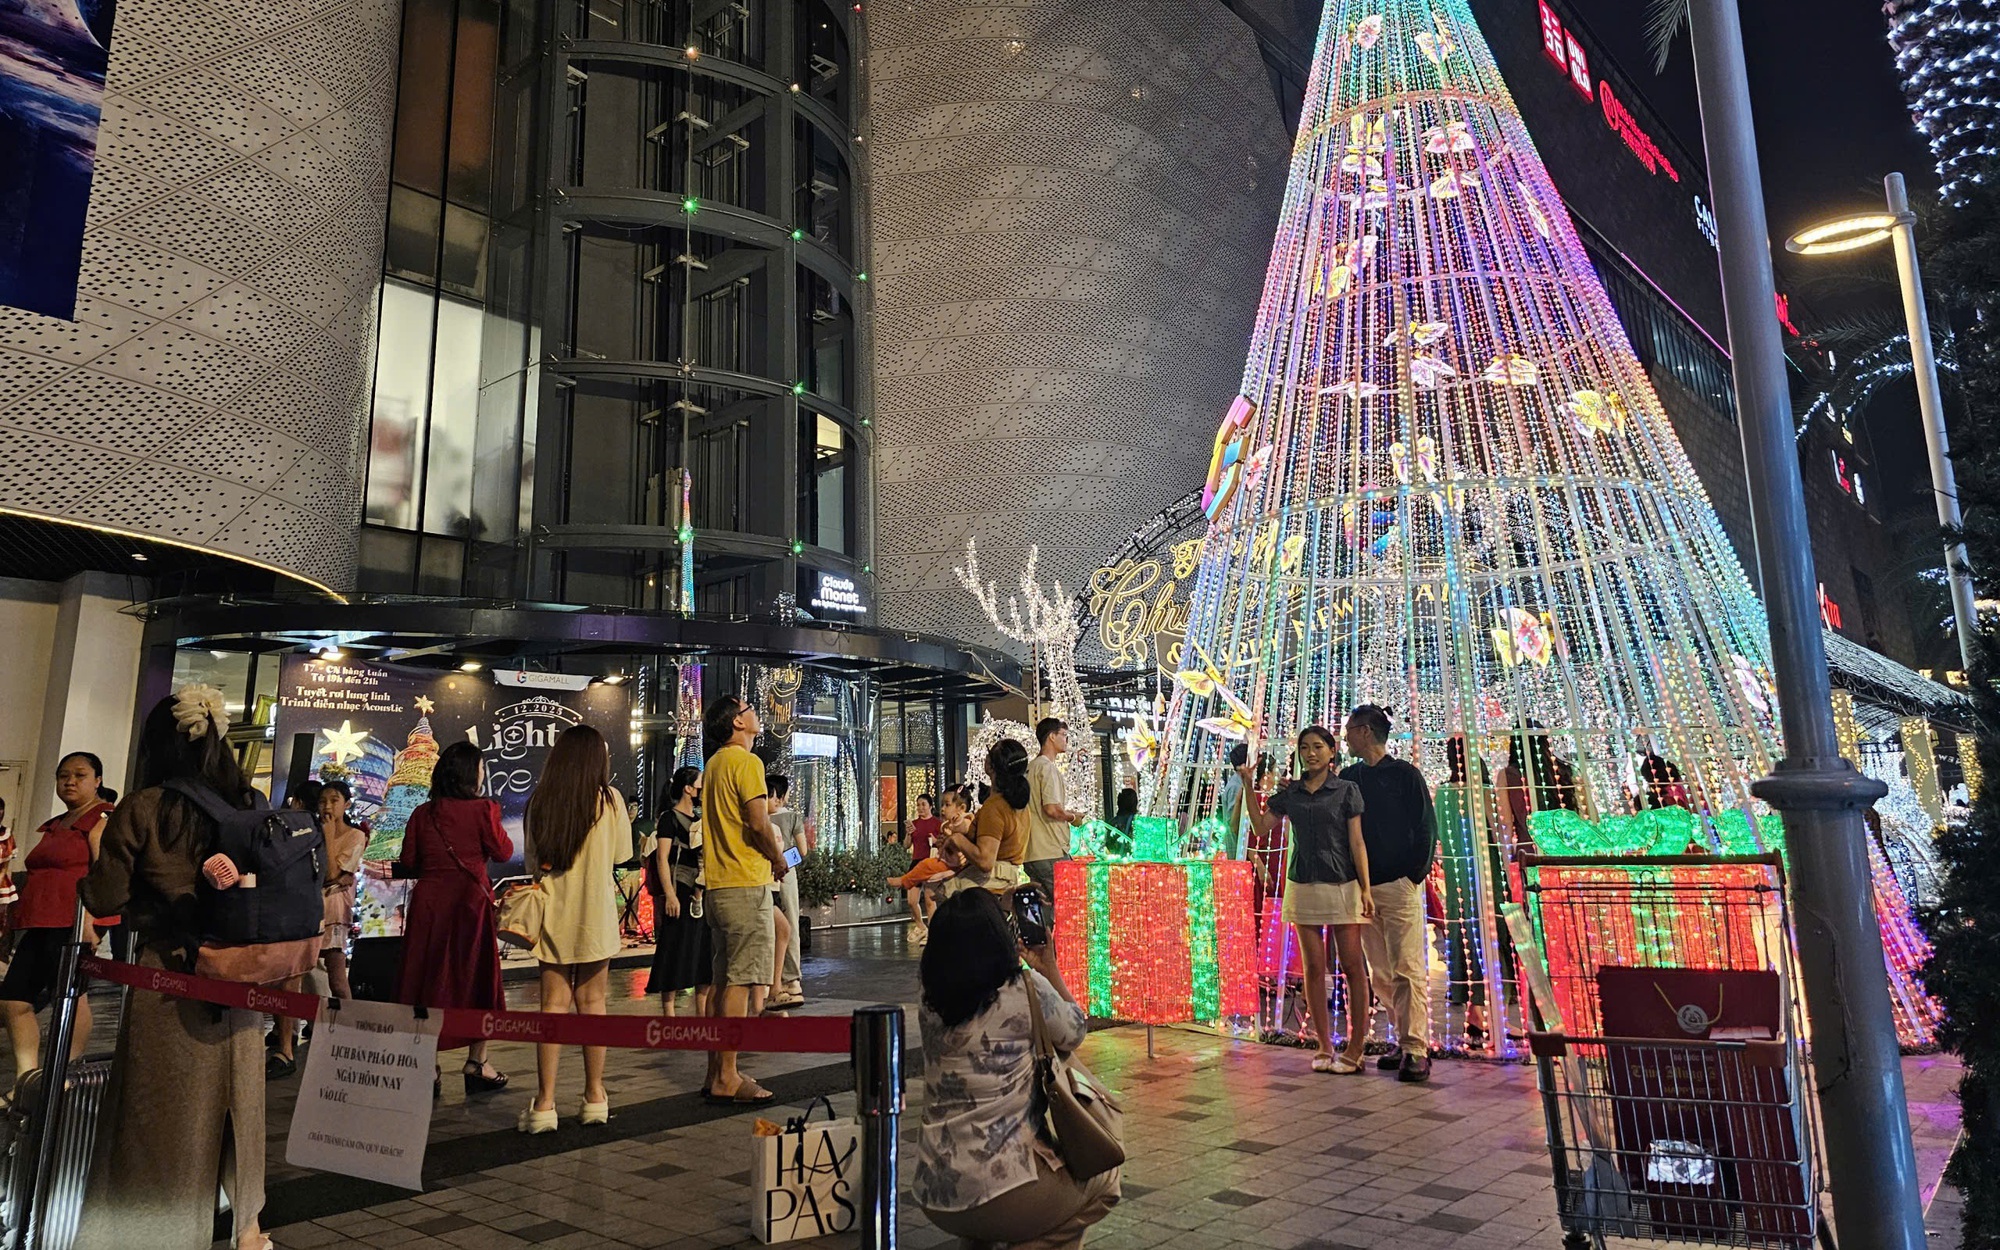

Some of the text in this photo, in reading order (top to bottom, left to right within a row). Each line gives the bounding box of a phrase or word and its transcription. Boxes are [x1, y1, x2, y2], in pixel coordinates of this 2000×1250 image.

[822, 576, 854, 591] Claude
[820, 587, 859, 604] Monet
[303, 663, 316, 673] T7
[342, 666, 365, 677] hàng
[529, 671, 570, 685] GIGAMALL
[326, 673, 343, 683] 19h
[363, 677, 379, 686] 21h
[296, 685, 327, 699] Tuyết
[346, 689, 369, 702] lung
[370, 691, 391, 701] linh
[280, 696, 311, 707] Trình
[336, 700, 361, 712] nhạc
[362, 702, 404, 713] Acoustic
[514, 703, 563, 717] 12.2025
[465, 720, 561, 760] Light
[160, 977, 188, 992] GIGAMALL
[257, 996, 288, 1009] GIGAMALL
[495, 1018, 542, 1034] GIGAMALL
[662, 1026, 721, 1042] GIGAMALL
[331, 1044, 350, 1061] LỊCH
[367, 1047, 396, 1066] PHÁO
[396, 1054, 418, 1069] HOA
[359, 1070, 380, 1088] HÔM
[381, 1075, 405, 1091] NAY
[776, 1130, 843, 1187] HA
[766, 1180, 856, 1243] PAS
